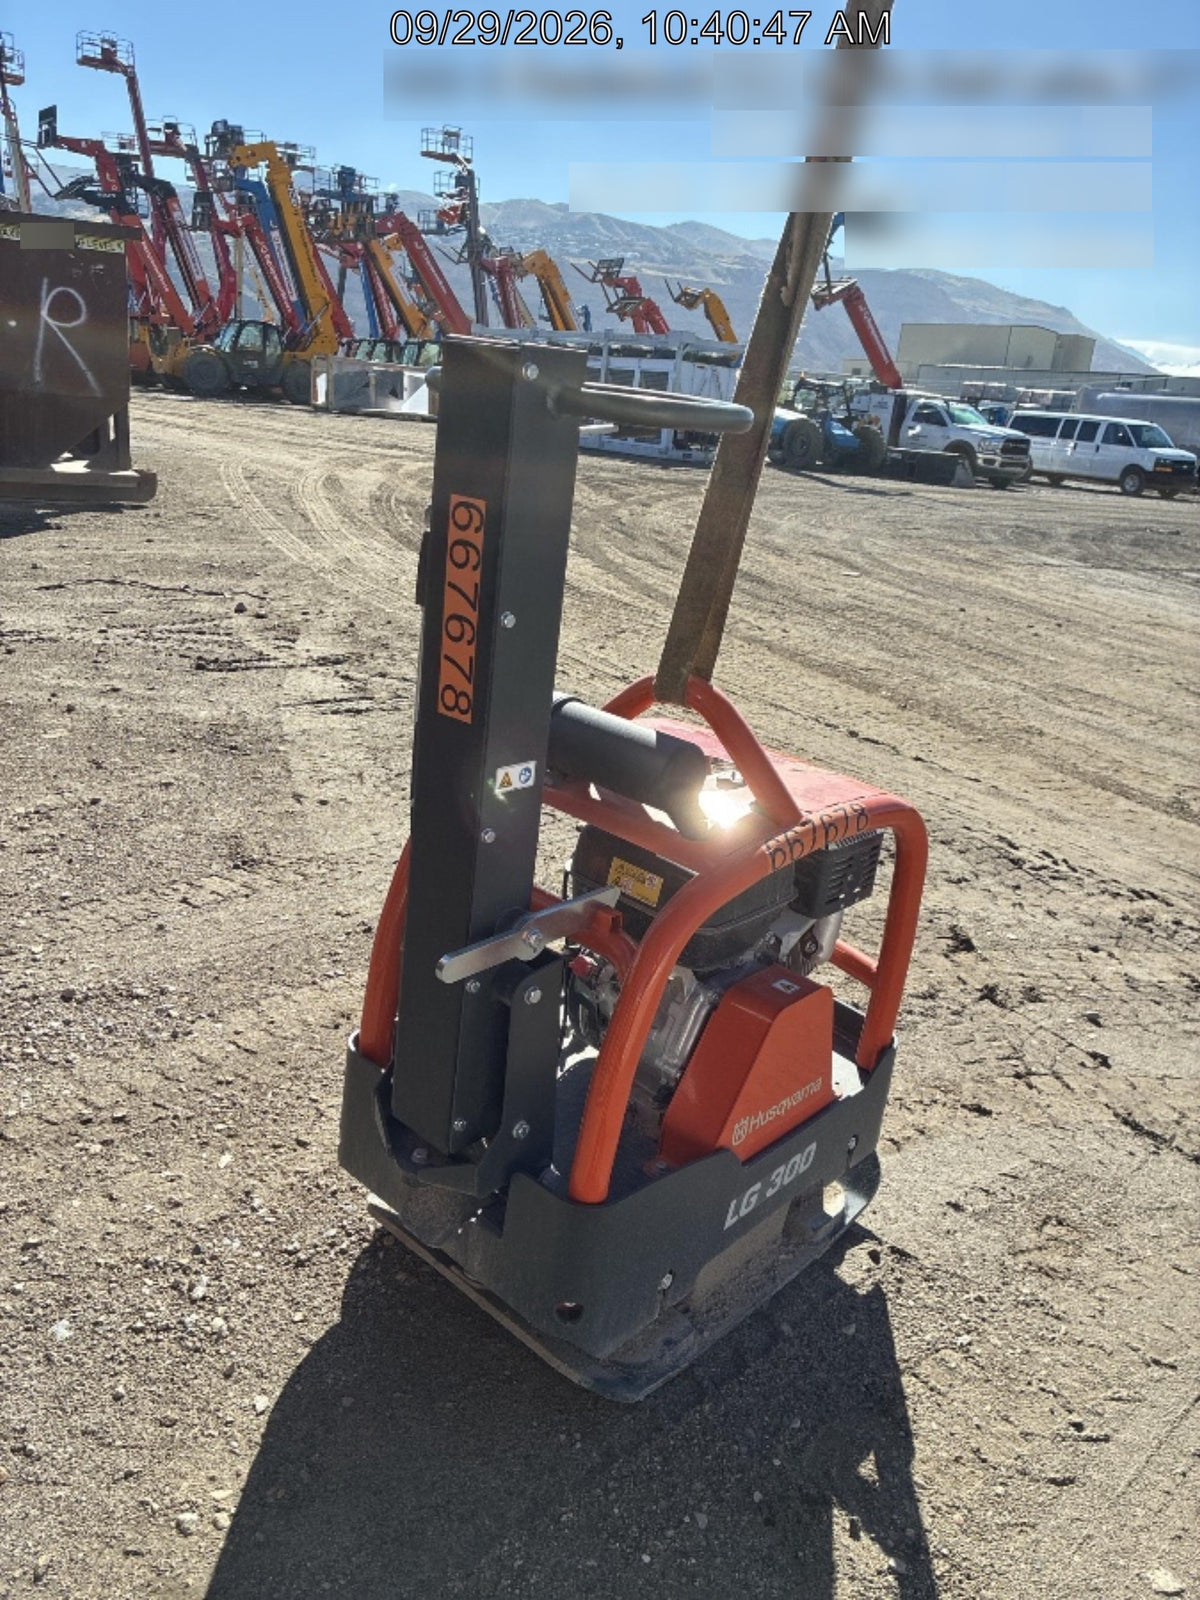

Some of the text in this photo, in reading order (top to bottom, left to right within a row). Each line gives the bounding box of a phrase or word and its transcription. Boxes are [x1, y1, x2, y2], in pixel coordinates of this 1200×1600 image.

[34, 277, 103, 397] R
[440, 501, 485, 715] 667678
[748, 1077, 823, 1133] Husqvarna
[723, 1141, 817, 1231] LG 300
